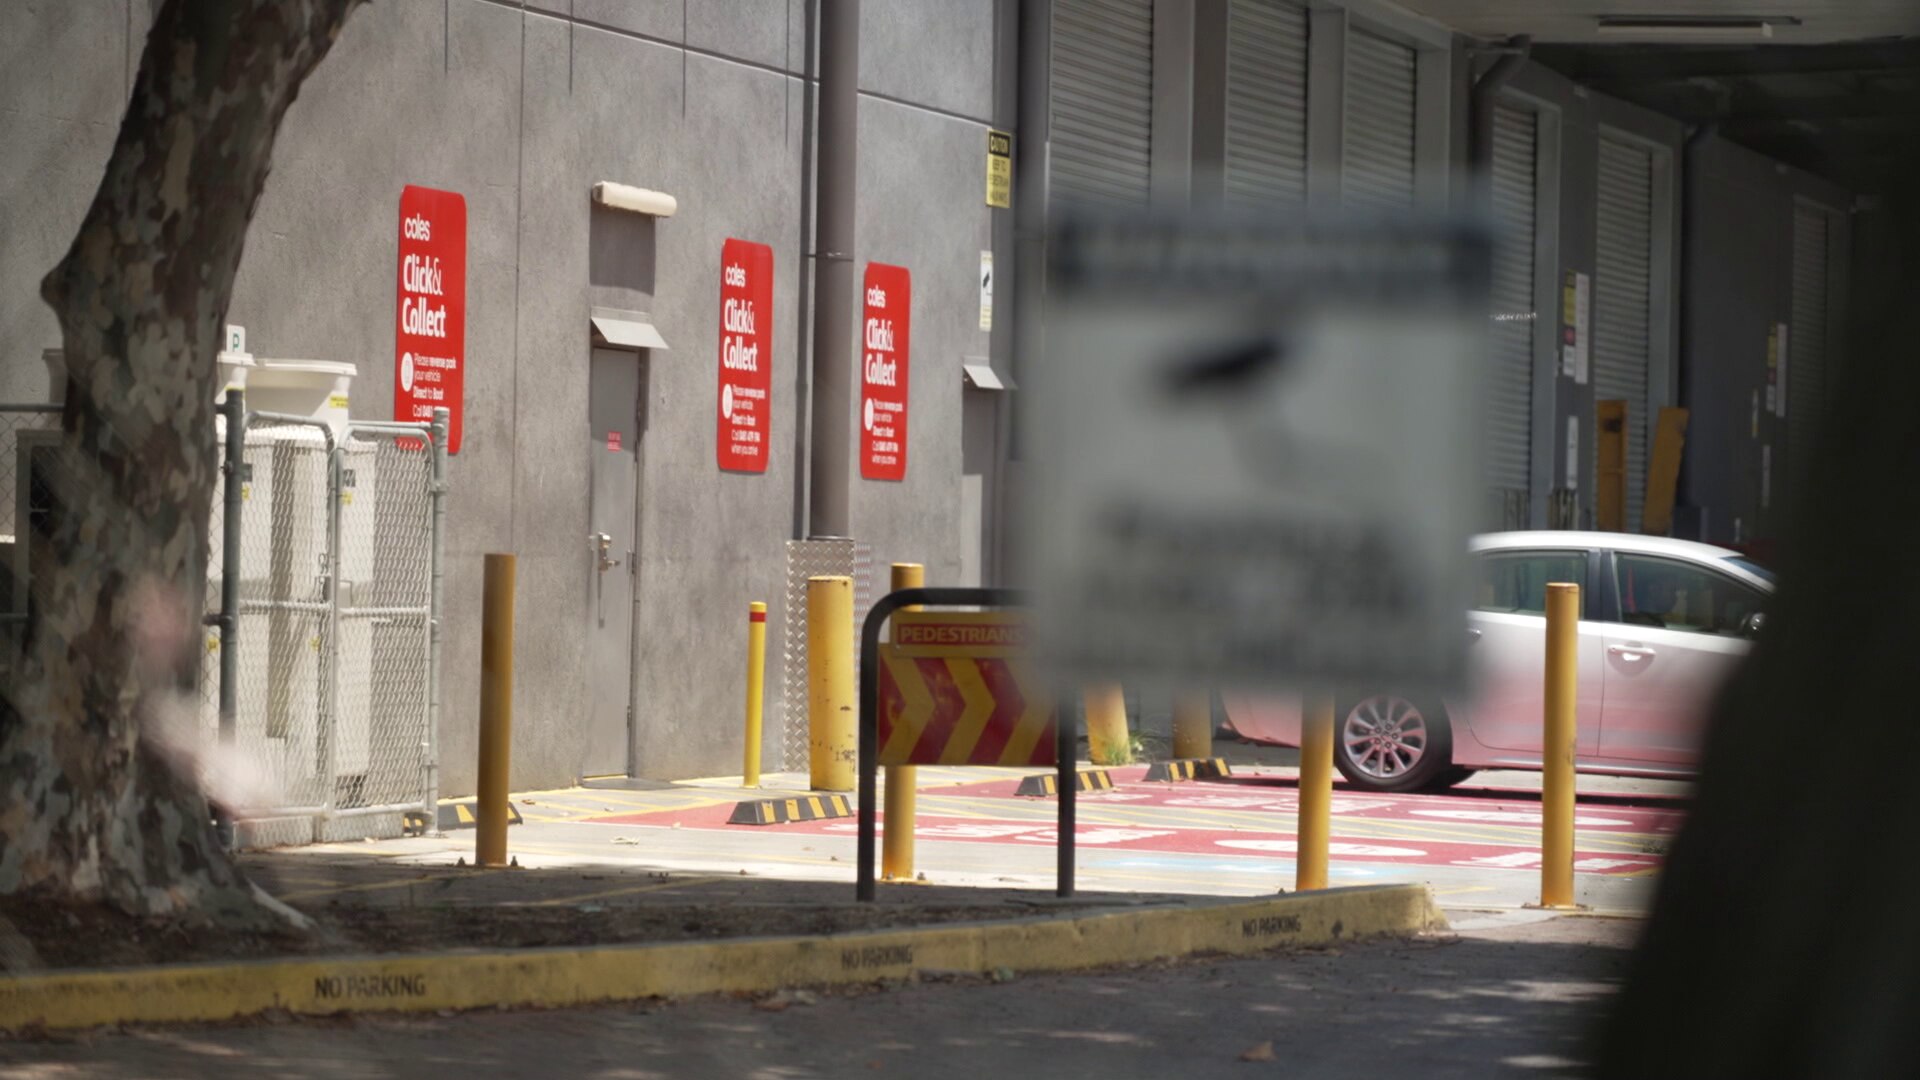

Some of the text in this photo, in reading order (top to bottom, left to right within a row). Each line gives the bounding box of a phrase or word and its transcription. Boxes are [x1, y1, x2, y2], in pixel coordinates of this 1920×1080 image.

[405, 213, 430, 241] coles
[403, 253, 443, 296] Click&
[725, 262, 746, 288] coles
[867, 284, 886, 308] coles
[402, 297, 446, 338] Collect
[724, 298, 756, 335] Click&
[233, 333, 240, 352] P
[723, 335, 758, 372] Collect
[414, 352, 429, 367] Please
[865, 352, 897, 386] Collect
[413, 386, 427, 399] Direct
[433, 387, 444, 400] Boot
[413, 404, 422, 417] Call
[901, 626, 1024, 643] PEDESTRIANS
[1242, 914, 1301, 938] NO PARKING
[841, 944, 913, 970] NO PARKING
[314, 973, 426, 999] NO PARKING
